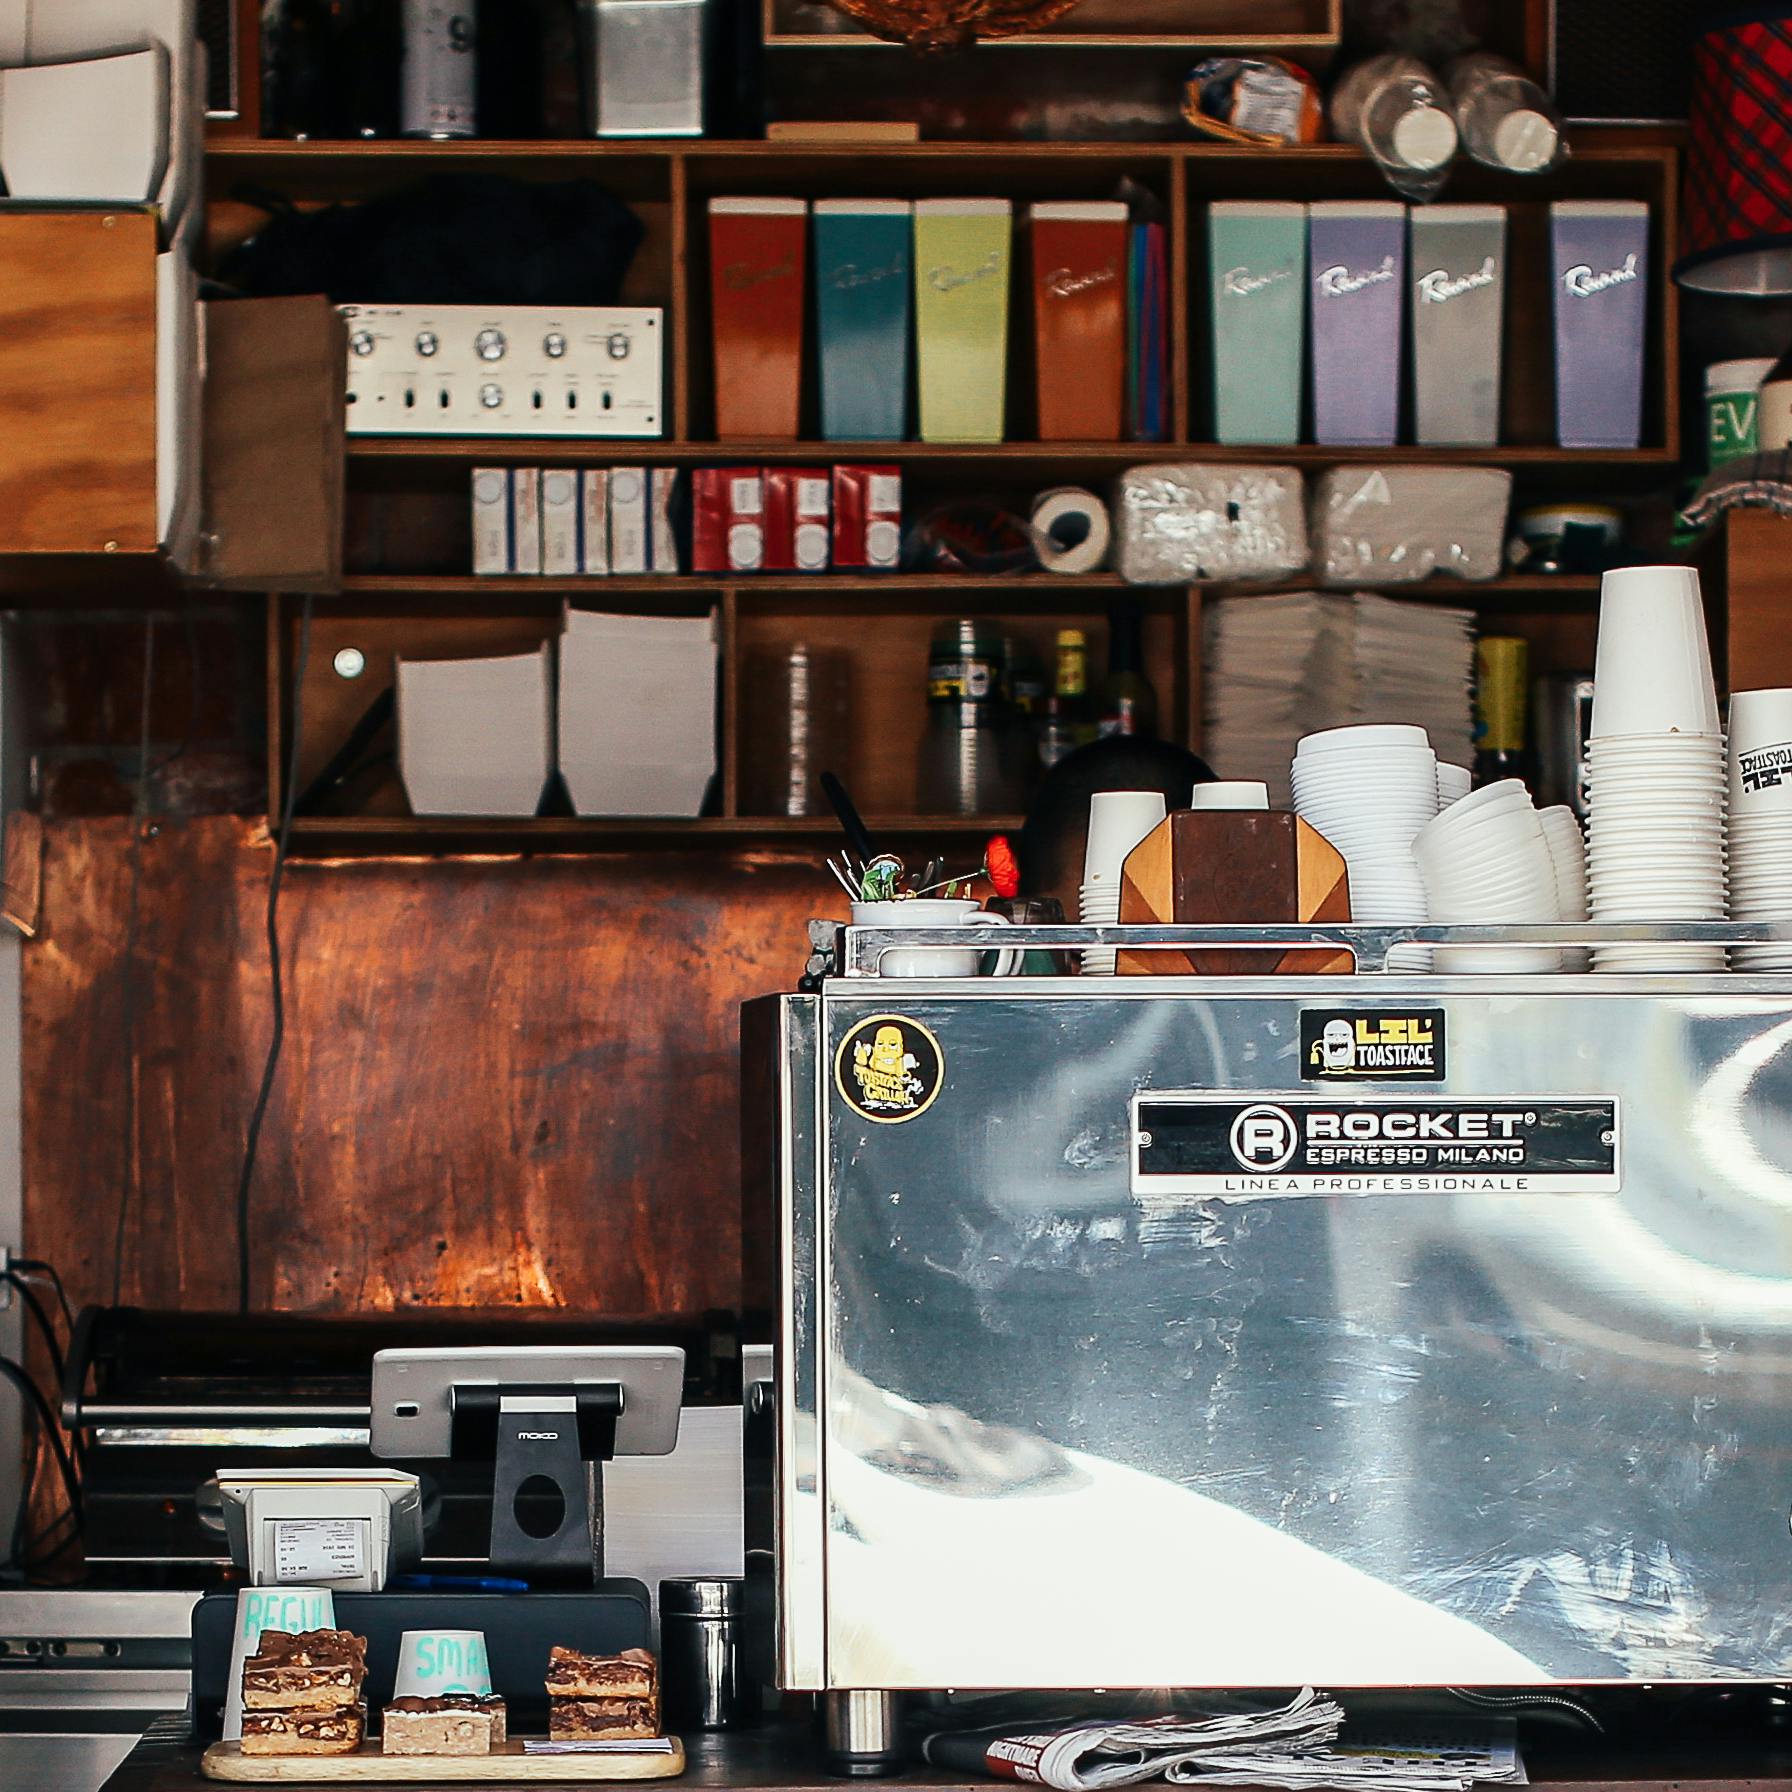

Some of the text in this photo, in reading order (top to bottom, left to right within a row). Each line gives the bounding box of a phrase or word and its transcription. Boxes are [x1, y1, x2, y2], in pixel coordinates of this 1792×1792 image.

[1356, 1018, 1432, 1044] LIL'
[1356, 1045, 1434, 1066] TOASTFACE
[1306, 1112, 1524, 1138] ROCKET
[1305, 1148, 1525, 1164] ESPRESSO MILANO
[1225, 1178, 1529, 1191] LINEA PROFESSIONALE
